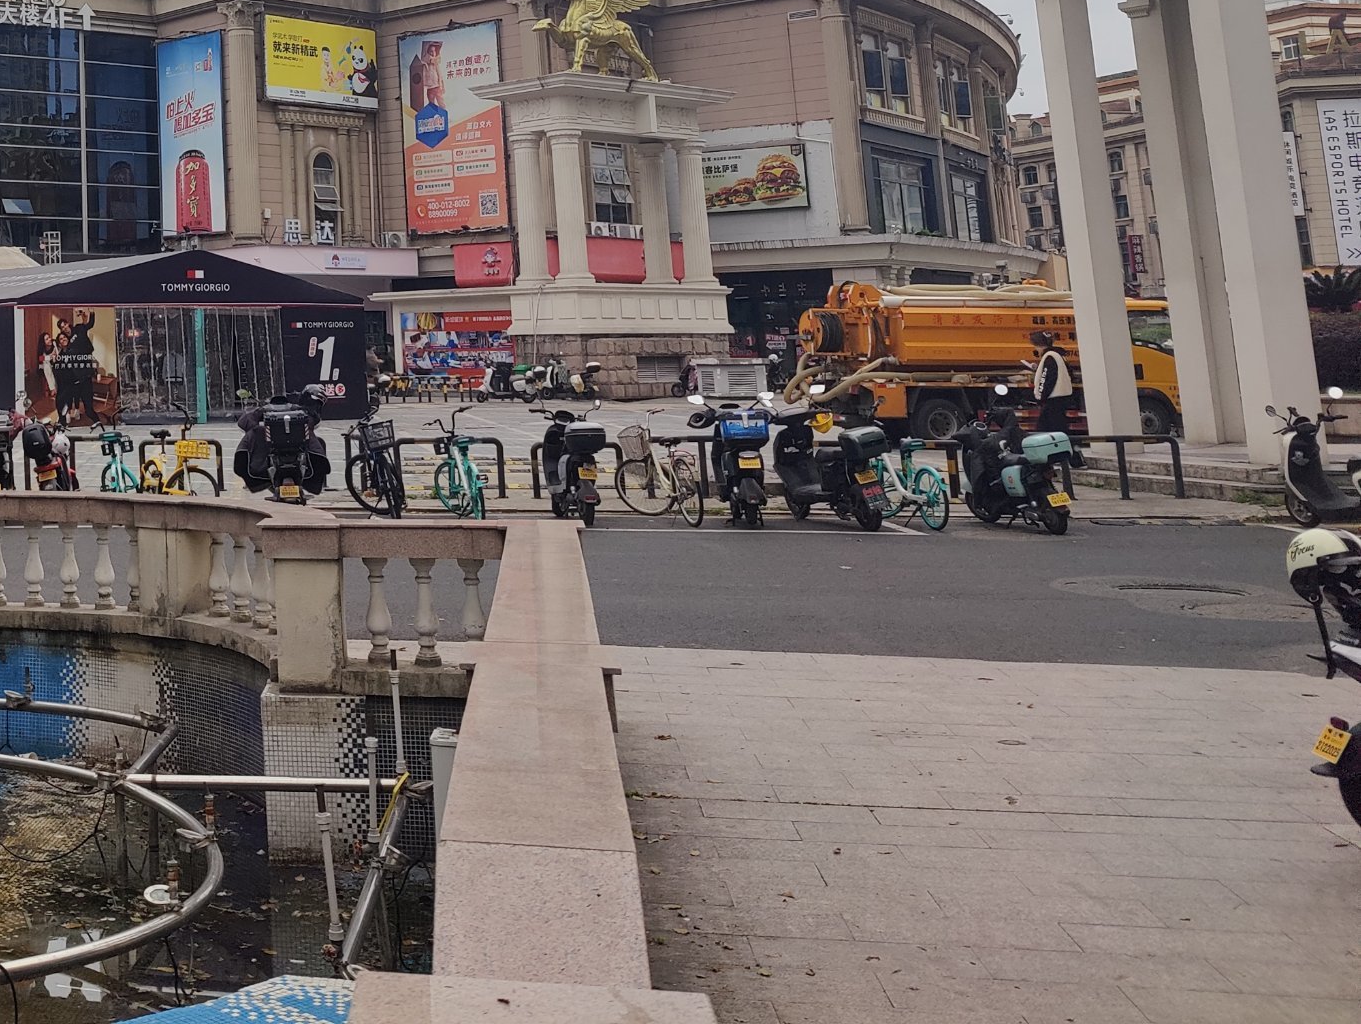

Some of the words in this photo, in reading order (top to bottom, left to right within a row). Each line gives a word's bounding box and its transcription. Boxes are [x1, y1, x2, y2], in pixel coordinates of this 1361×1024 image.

[273, 41, 318, 58] 就来新精武
[166, 90, 195, 119] 怕上火
[1336, 200, 1353, 238] HOTEL
[161, 283, 231, 292] TOMMYGIORGIO
